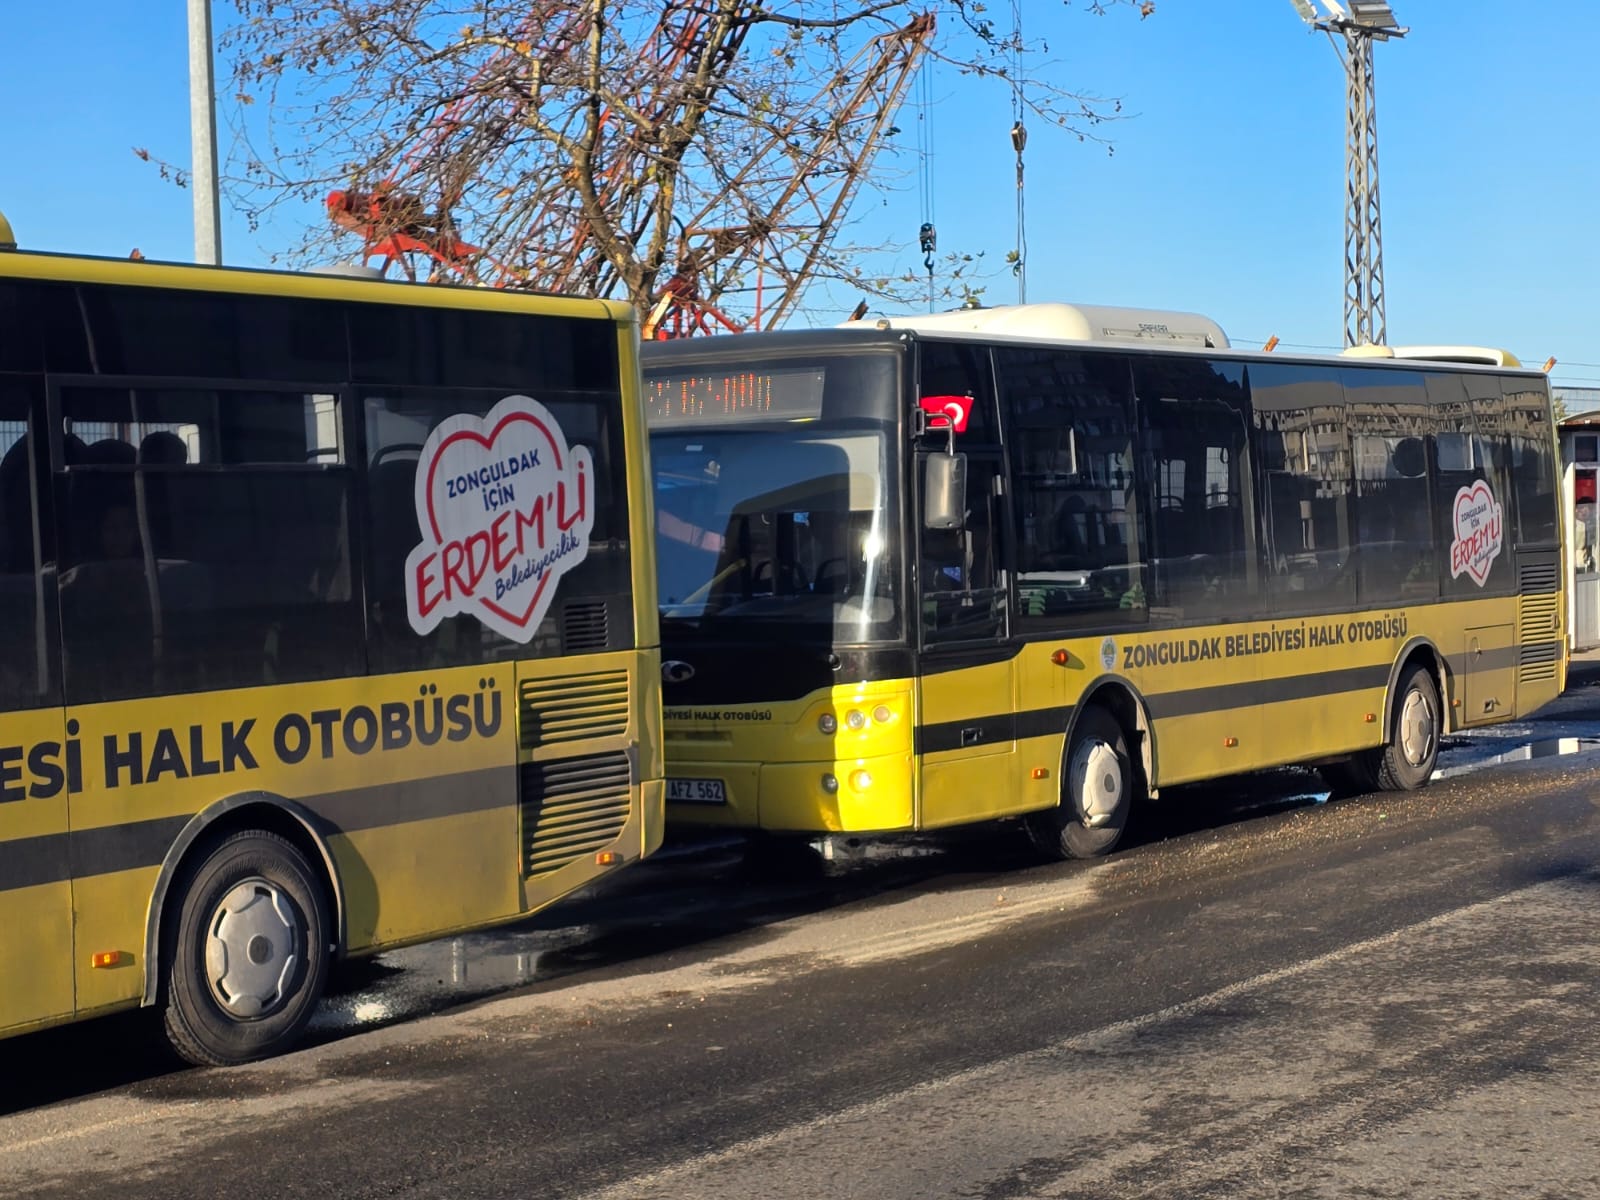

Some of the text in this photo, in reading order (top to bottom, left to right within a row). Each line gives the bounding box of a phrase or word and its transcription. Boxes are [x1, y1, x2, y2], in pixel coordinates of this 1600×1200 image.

[446, 449, 541, 498] ZONGULDAK
[483, 484, 515, 511] İÇİN
[416, 460, 586, 618] ERDEM'Lİ
[495, 529, 580, 601] Belediyecilik
[1123, 612, 1408, 670] ZONGULDAK BELEDİYESİ HALK OTOBÜSÜ
[103, 718, 260, 788] HALK
[273, 676, 502, 765] OTOBÜSÜ
[694, 711, 720, 721] HALK
[723, 709, 772, 721] OTOBÜSÜ
[670, 782, 722, 800] AFZ 562
